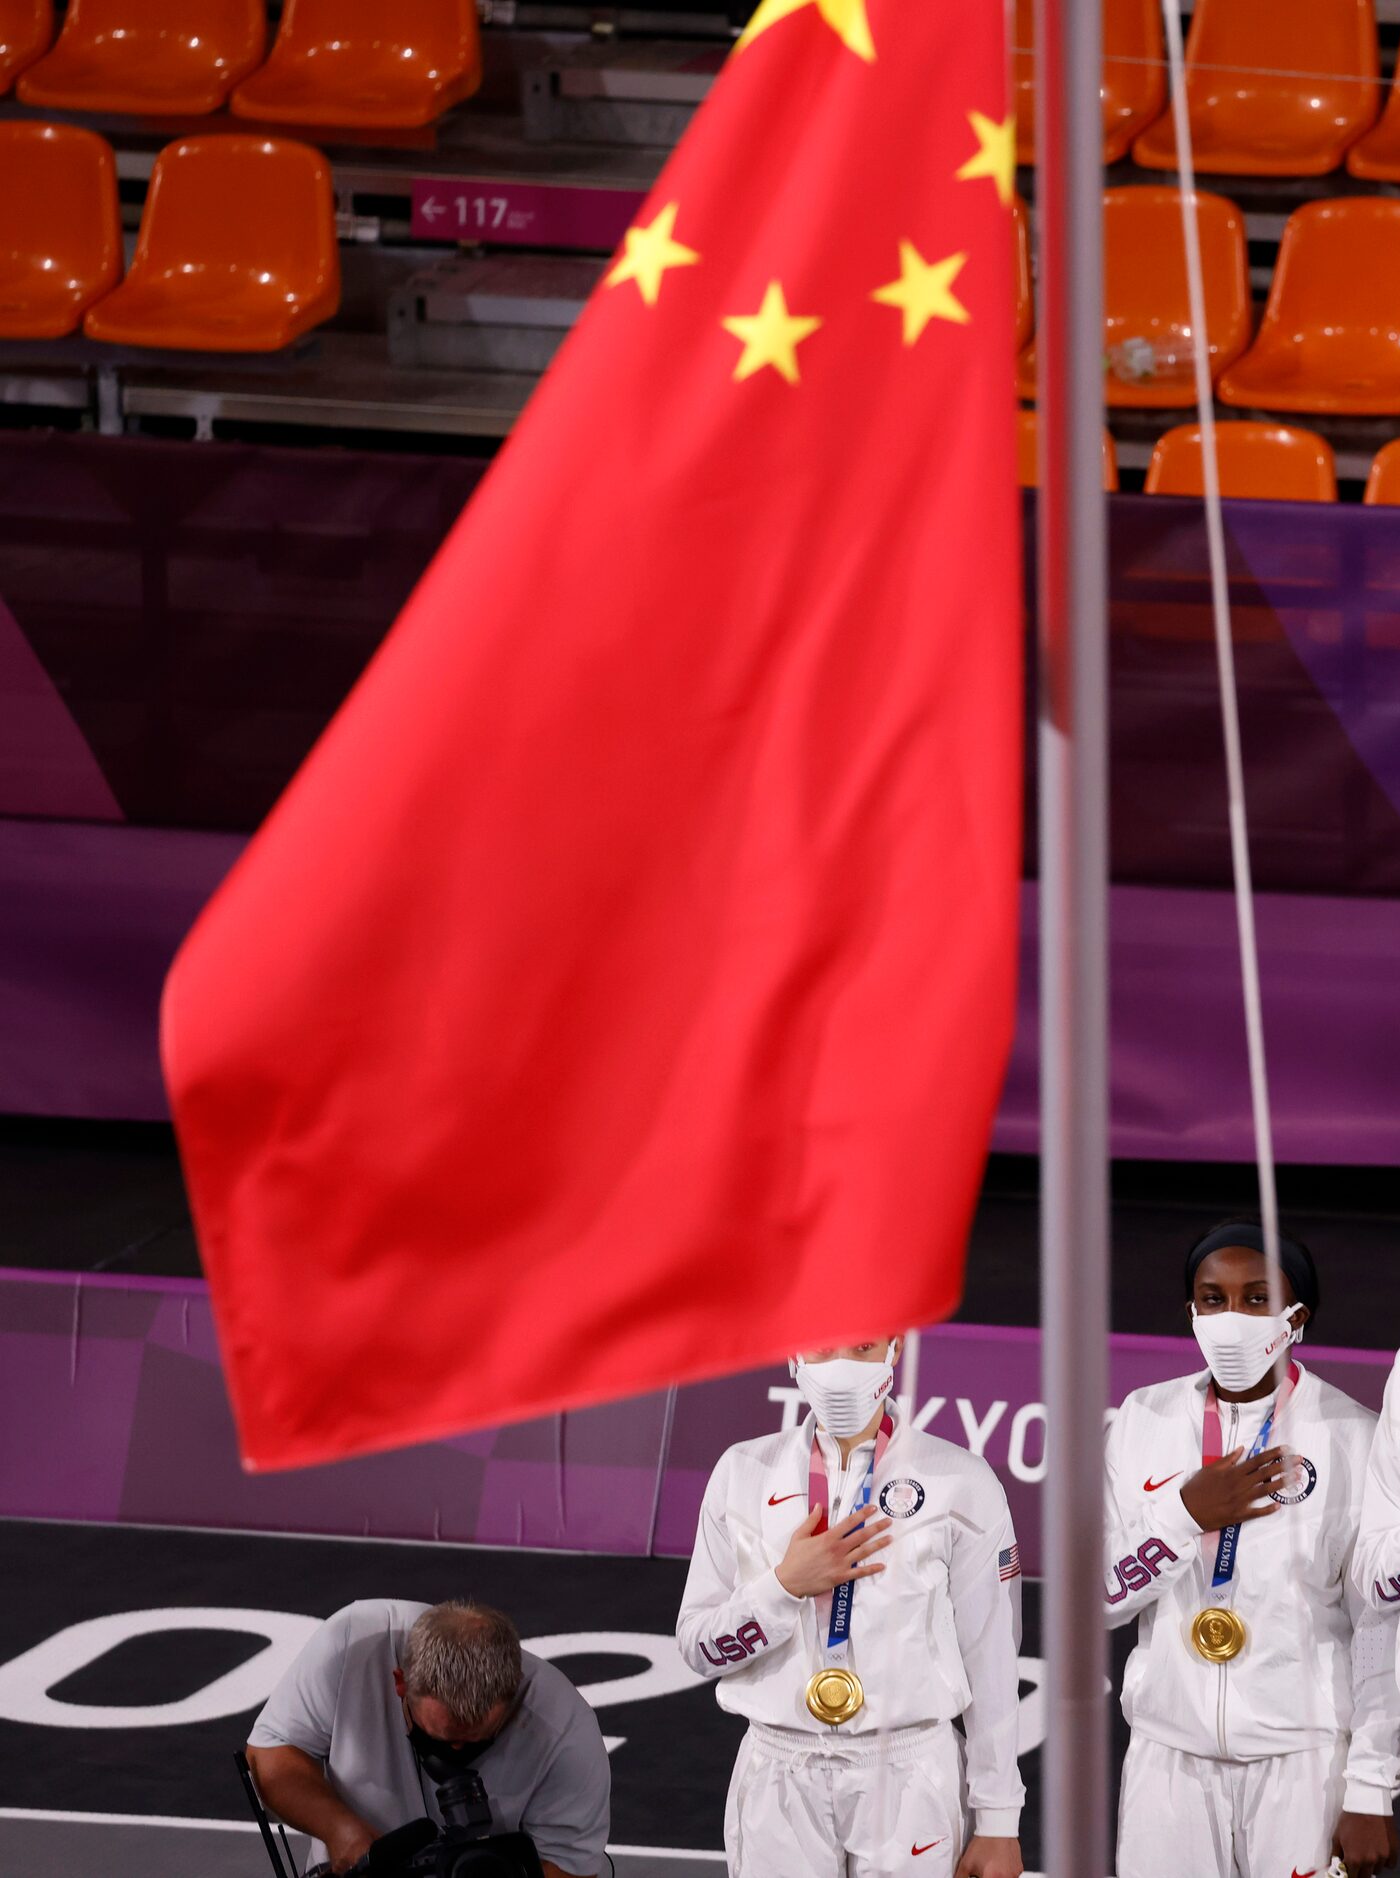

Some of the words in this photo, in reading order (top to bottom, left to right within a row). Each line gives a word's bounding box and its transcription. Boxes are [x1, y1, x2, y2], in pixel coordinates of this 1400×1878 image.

[454, 197, 508, 228] 117
[1265, 1330, 1289, 1355] USA
[874, 1375, 892, 1400] USA
[1225, 1525, 1236, 1540] 20
[1104, 1537, 1179, 1605] USA
[1219, 1540, 1232, 1573] TOKYO
[839, 1582, 850, 1599] 20
[834, 1599, 848, 1633] TOKYO
[699, 1621, 769, 1666] USA
